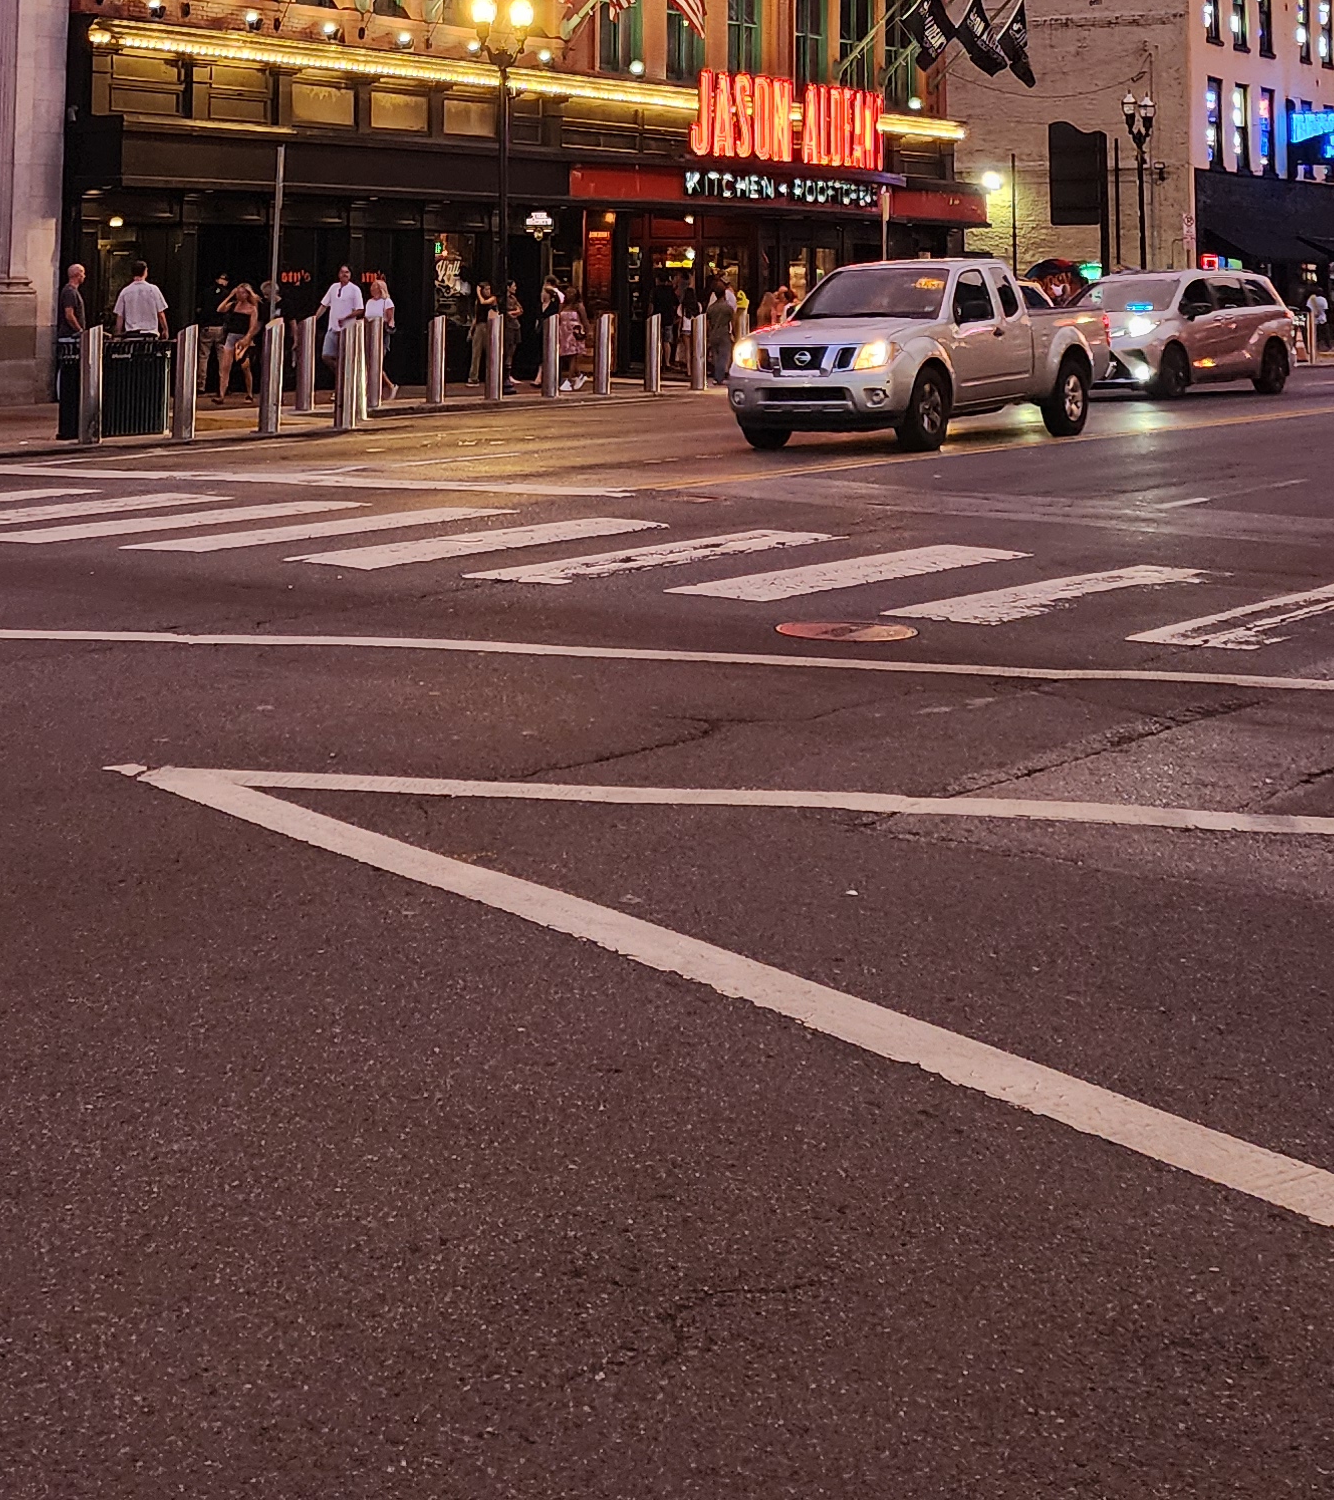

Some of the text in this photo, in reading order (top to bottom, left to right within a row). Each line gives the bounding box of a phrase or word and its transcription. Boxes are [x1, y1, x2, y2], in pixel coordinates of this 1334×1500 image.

[690, 68, 885, 172] JASON ALDEAN'S
[684, 170, 776, 200] KITCHEN
